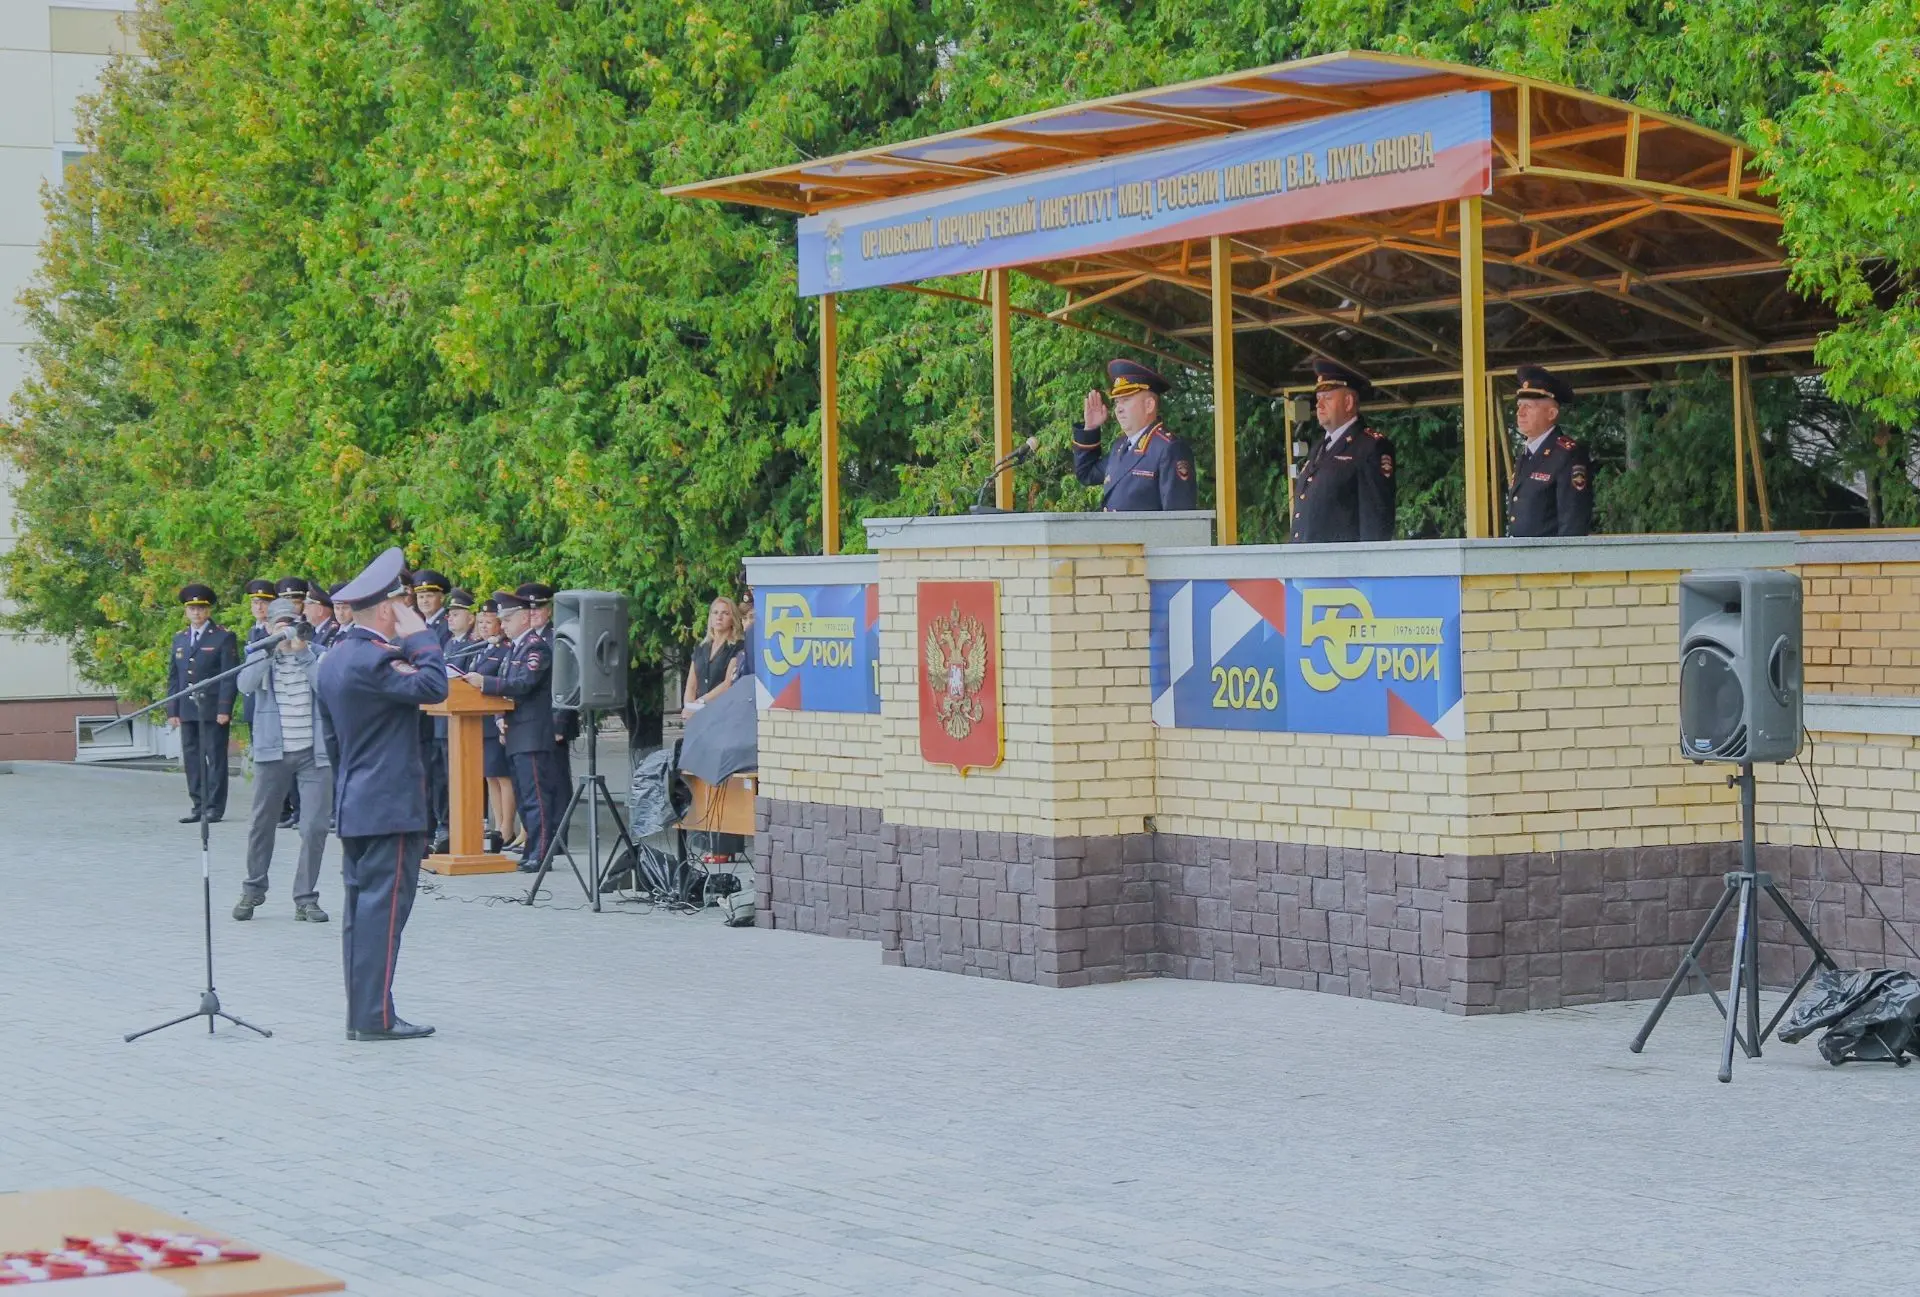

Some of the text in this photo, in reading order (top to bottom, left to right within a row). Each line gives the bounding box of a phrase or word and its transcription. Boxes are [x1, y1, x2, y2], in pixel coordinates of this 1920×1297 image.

[861, 131, 1436, 260] ОРЛОВСКИЙ ЮРИДИЧЕСКИЙ ИНСТИТУТ МВД РОССИИ ИМЕНИ В.В. ЛУКЬЯНОВА
[1348, 624, 1378, 639] ЛЕТ
[812, 641, 853, 668] РЮИ
[1376, 647, 1440, 681] РЮИ
[1212, 667, 1279, 711] 2026
